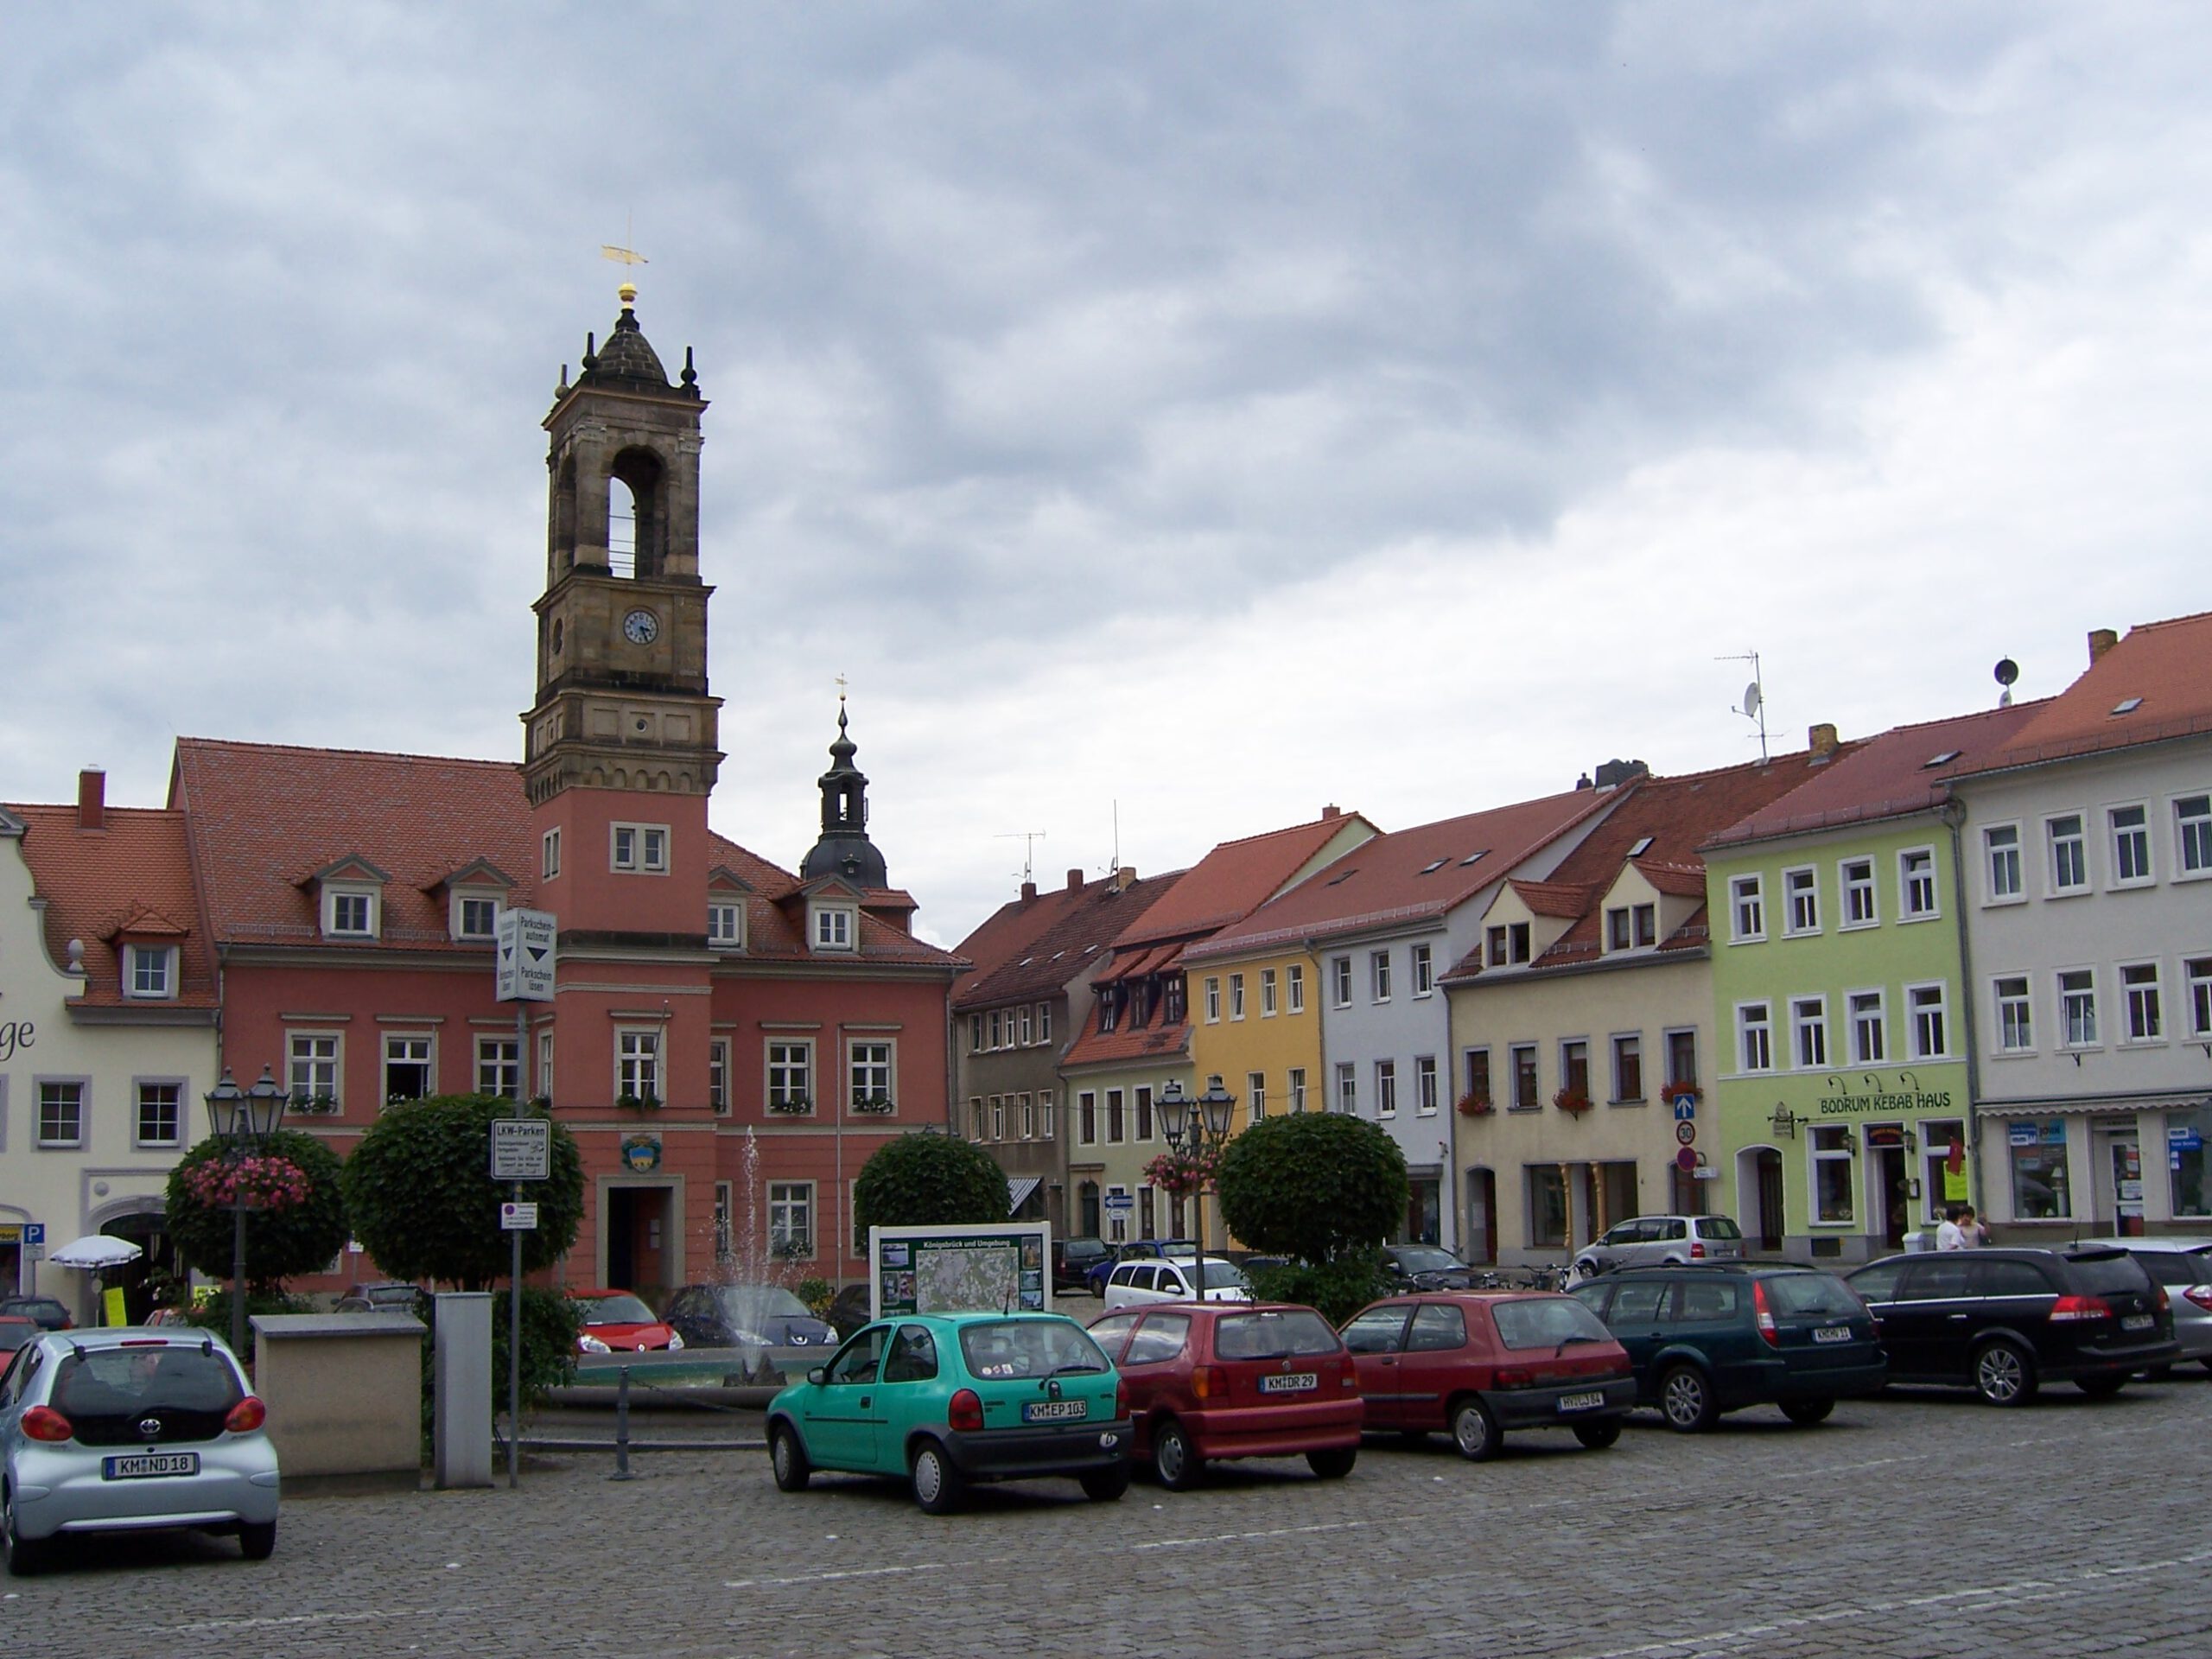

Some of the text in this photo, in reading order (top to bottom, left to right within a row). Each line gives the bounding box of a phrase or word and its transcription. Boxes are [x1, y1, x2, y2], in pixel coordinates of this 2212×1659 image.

[520, 916, 555, 931] Parkschein-
[525, 931, 550, 943] automat
[521, 966, 552, 981] Parkschein
[1821, 1091, 1951, 1114] BODRUM KEBAB HAUS
[497, 1125, 545, 1136] LKW-Parken
[1680, 1127, 1692, 1140] 30
[29, 1225, 40, 1243] P
[923, 1241, 963, 1250] Königsbrück
[977, 1238, 1011, 1249] Umgebung
[1268, 1375, 1313, 1389] KM DR 29
[1030, 1402, 1085, 1417] KM EP 103
[120, 1457, 188, 1473] KM ND 18
